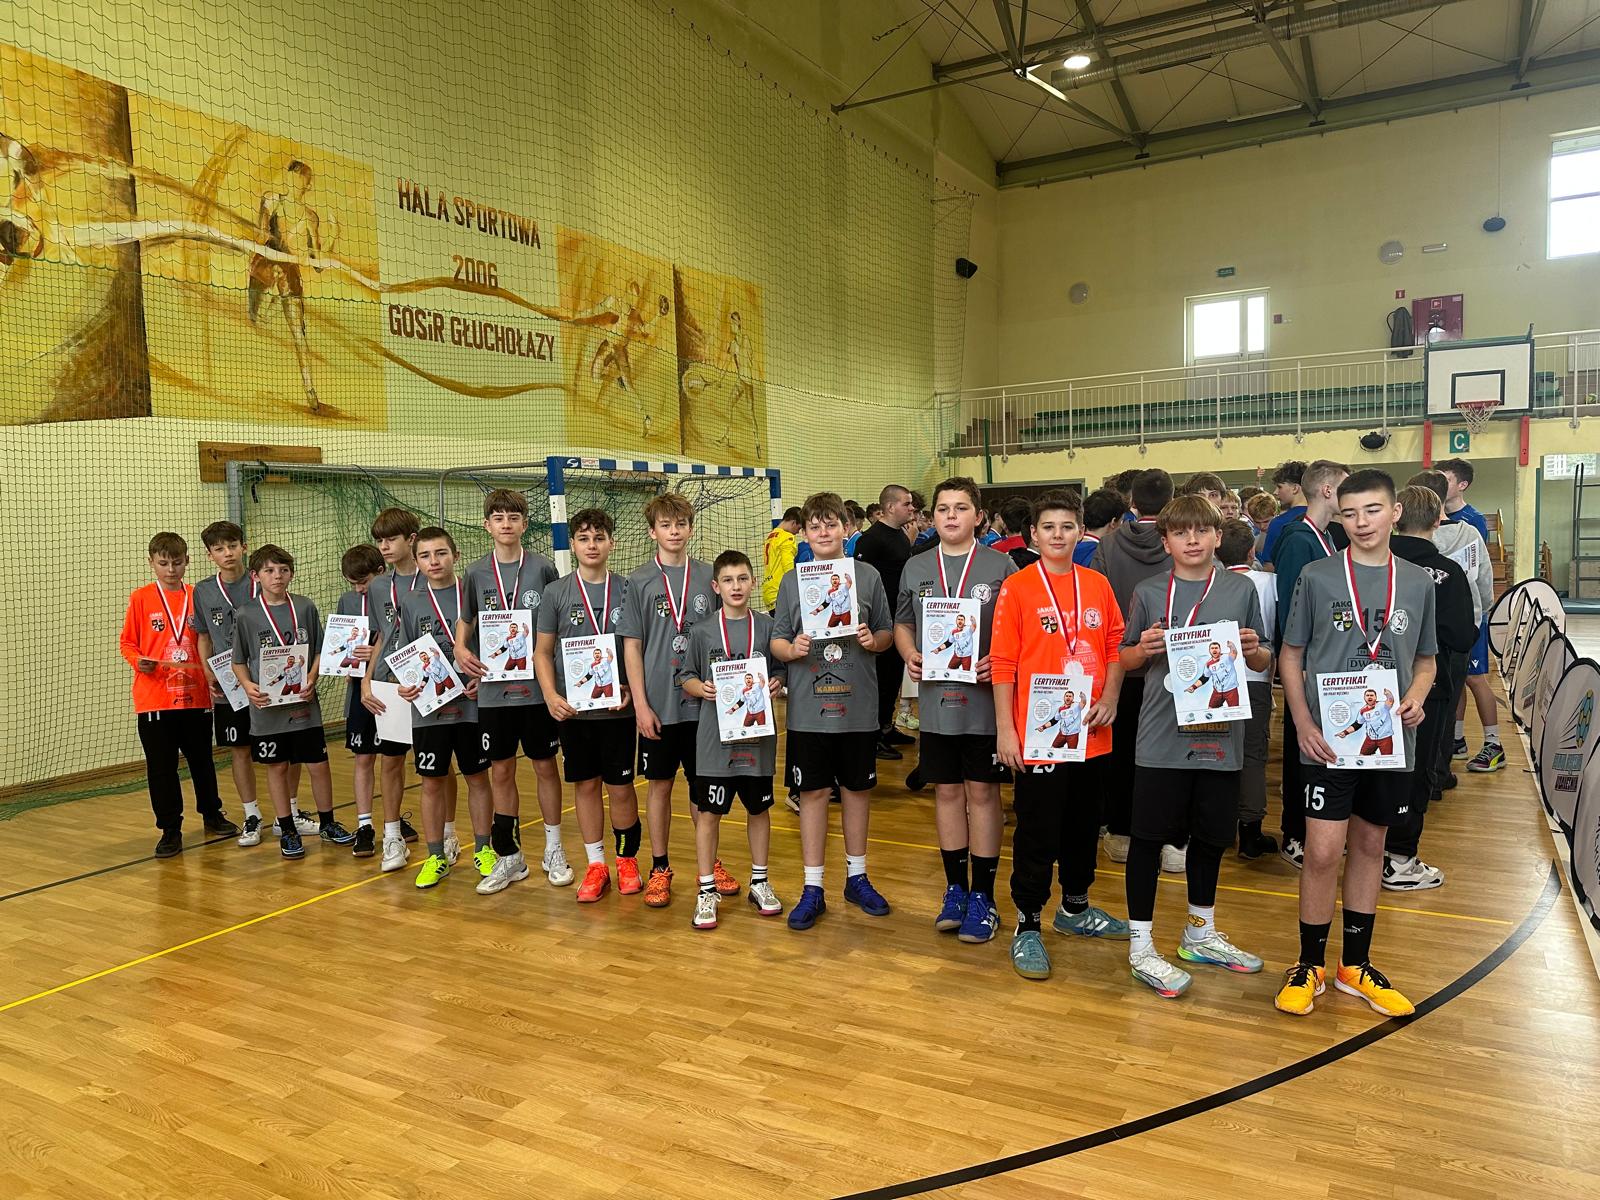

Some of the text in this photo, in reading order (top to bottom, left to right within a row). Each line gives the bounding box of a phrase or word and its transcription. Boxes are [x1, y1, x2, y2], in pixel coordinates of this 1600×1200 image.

[397, 177, 541, 250] HALA SPORTOWA
[452, 255, 499, 288] 2006
[450, 316, 555, 362] GŁUCHOŁAZY
[1454, 433, 1465, 450] C
[800, 563, 833, 573] CERTYFIKAT
[926, 602, 960, 610] CERTYFIKAT
[1331, 600, 1352, 608] JAKO
[329, 616, 357, 624] CERTYFIKAT
[481, 613, 513, 621] CERTYFIKAT
[1170, 629, 1211, 642] CERTYFIKAT
[564, 638, 596, 648] CERTYFIKAT
[262, 647, 291, 656] CERTYFIKAT
[389, 644, 418, 665] CERTYFIKAT
[715, 663, 747, 672] CERTYFIKAT
[1034, 677, 1070, 686] CERTYFIKAT
[1322, 676, 1368, 686] CERTYFIKAT
[225, 727, 237, 742] 10
[482, 732, 490, 751] 6
[259, 741, 277, 758] 32
[418, 752, 436, 770] 22
[708, 785, 725, 806] 50
[1303, 784, 1326, 811] 15
